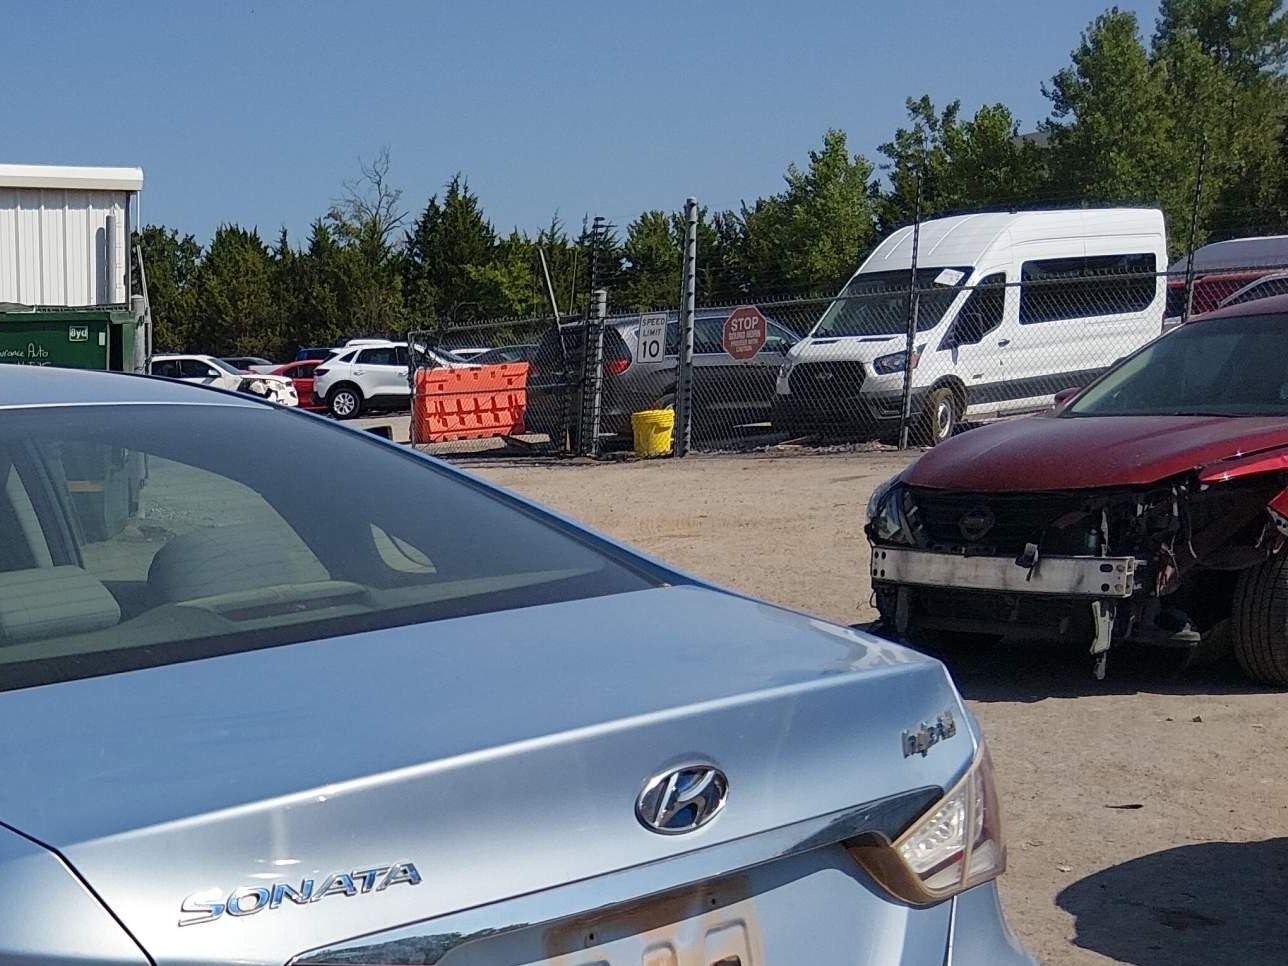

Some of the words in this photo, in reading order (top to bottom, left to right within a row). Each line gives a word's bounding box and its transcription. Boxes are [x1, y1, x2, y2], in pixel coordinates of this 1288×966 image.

[642, 317, 665, 326] SPEED
[731, 316, 759, 331] STOP
[27, 342, 49, 358] Auto
[642, 340, 660, 358] 10
[178, 861, 424, 928] SONATA
